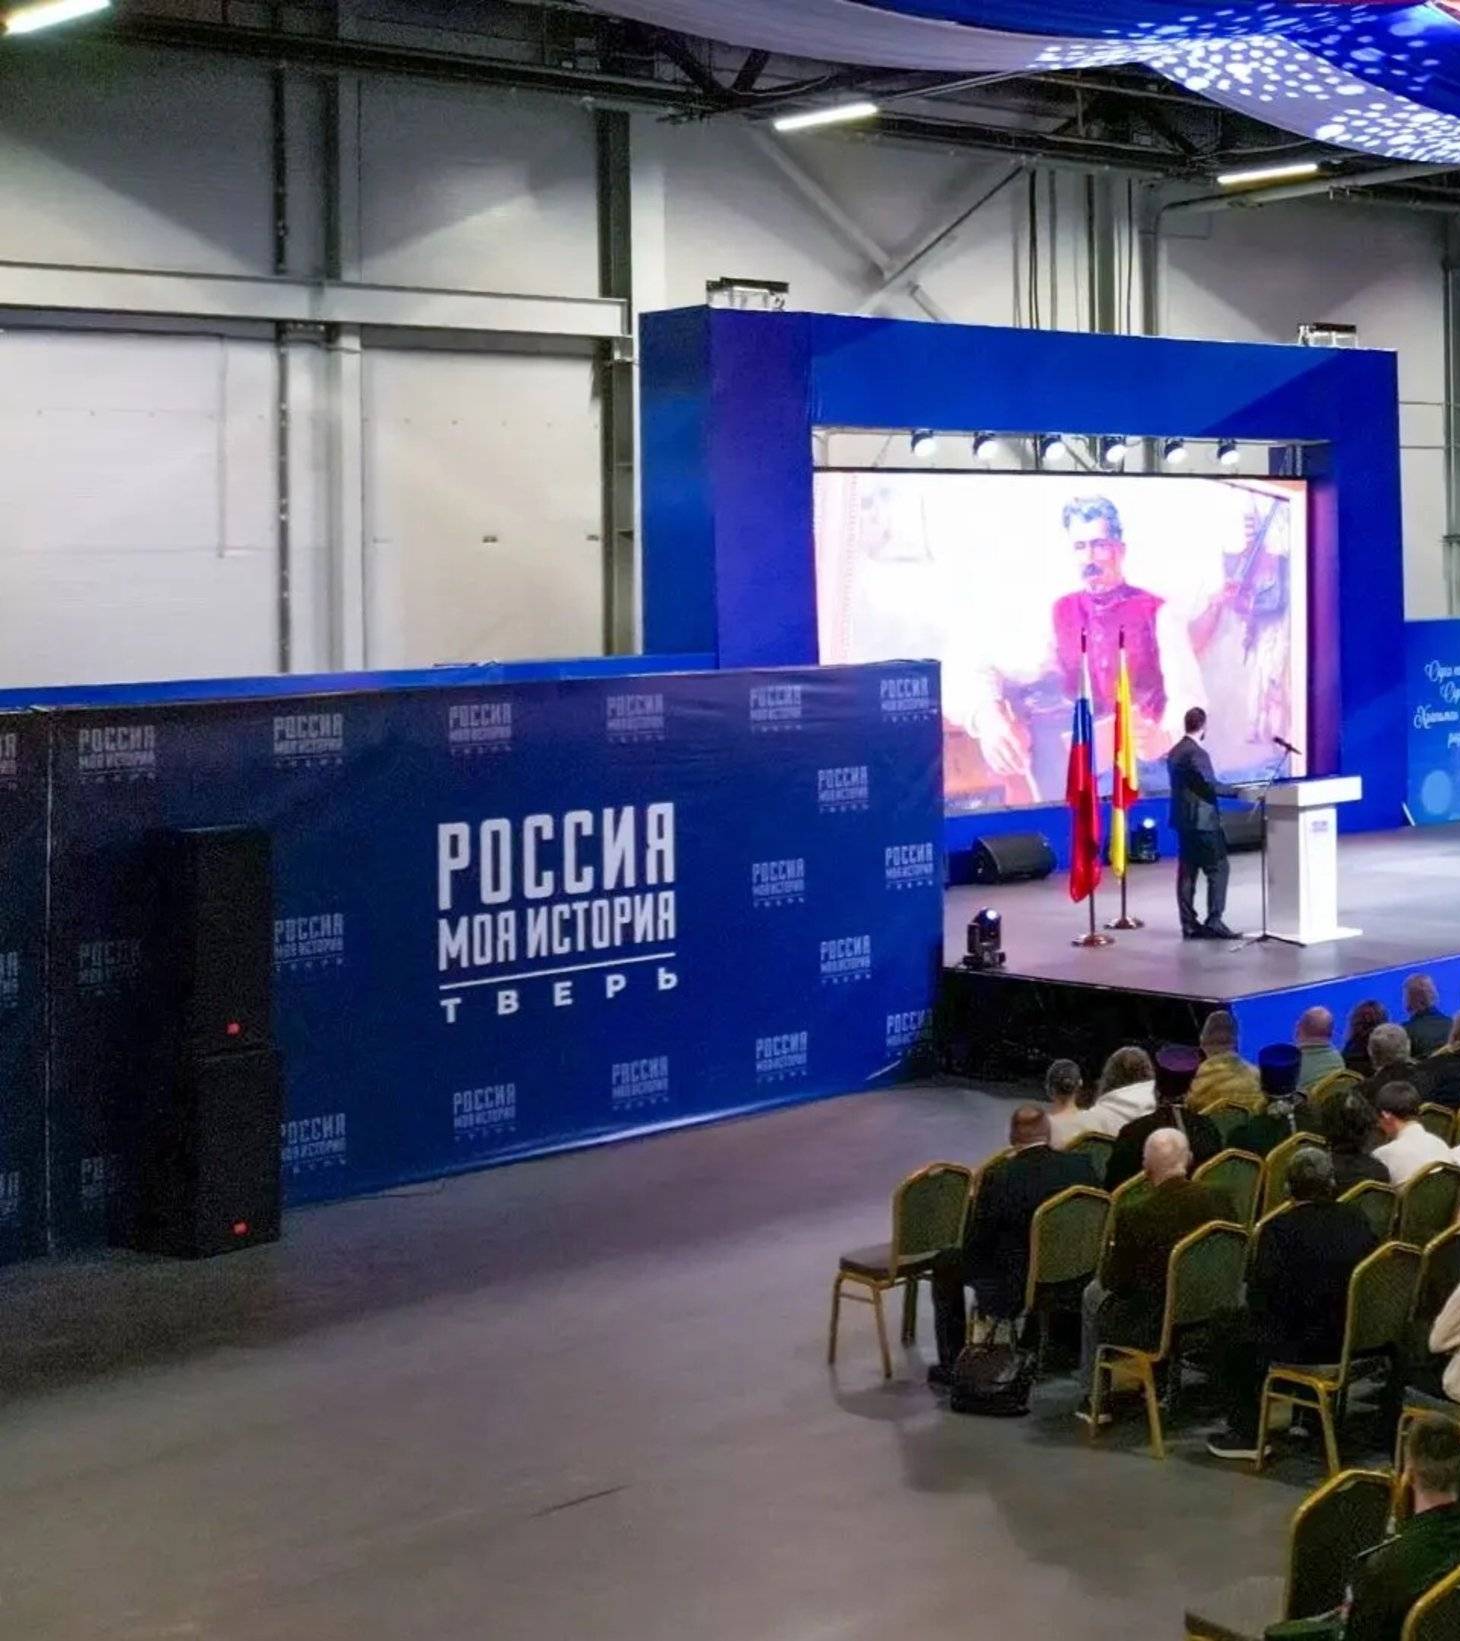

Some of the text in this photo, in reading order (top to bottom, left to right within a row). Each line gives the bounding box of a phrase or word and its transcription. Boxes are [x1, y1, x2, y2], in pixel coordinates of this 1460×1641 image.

[438, 802, 676, 910] РОССИЯ
[439, 891, 676, 971] МОЯ ИСТОРИЯ
[440, 967, 679, 1023] ТВЕРЬ
